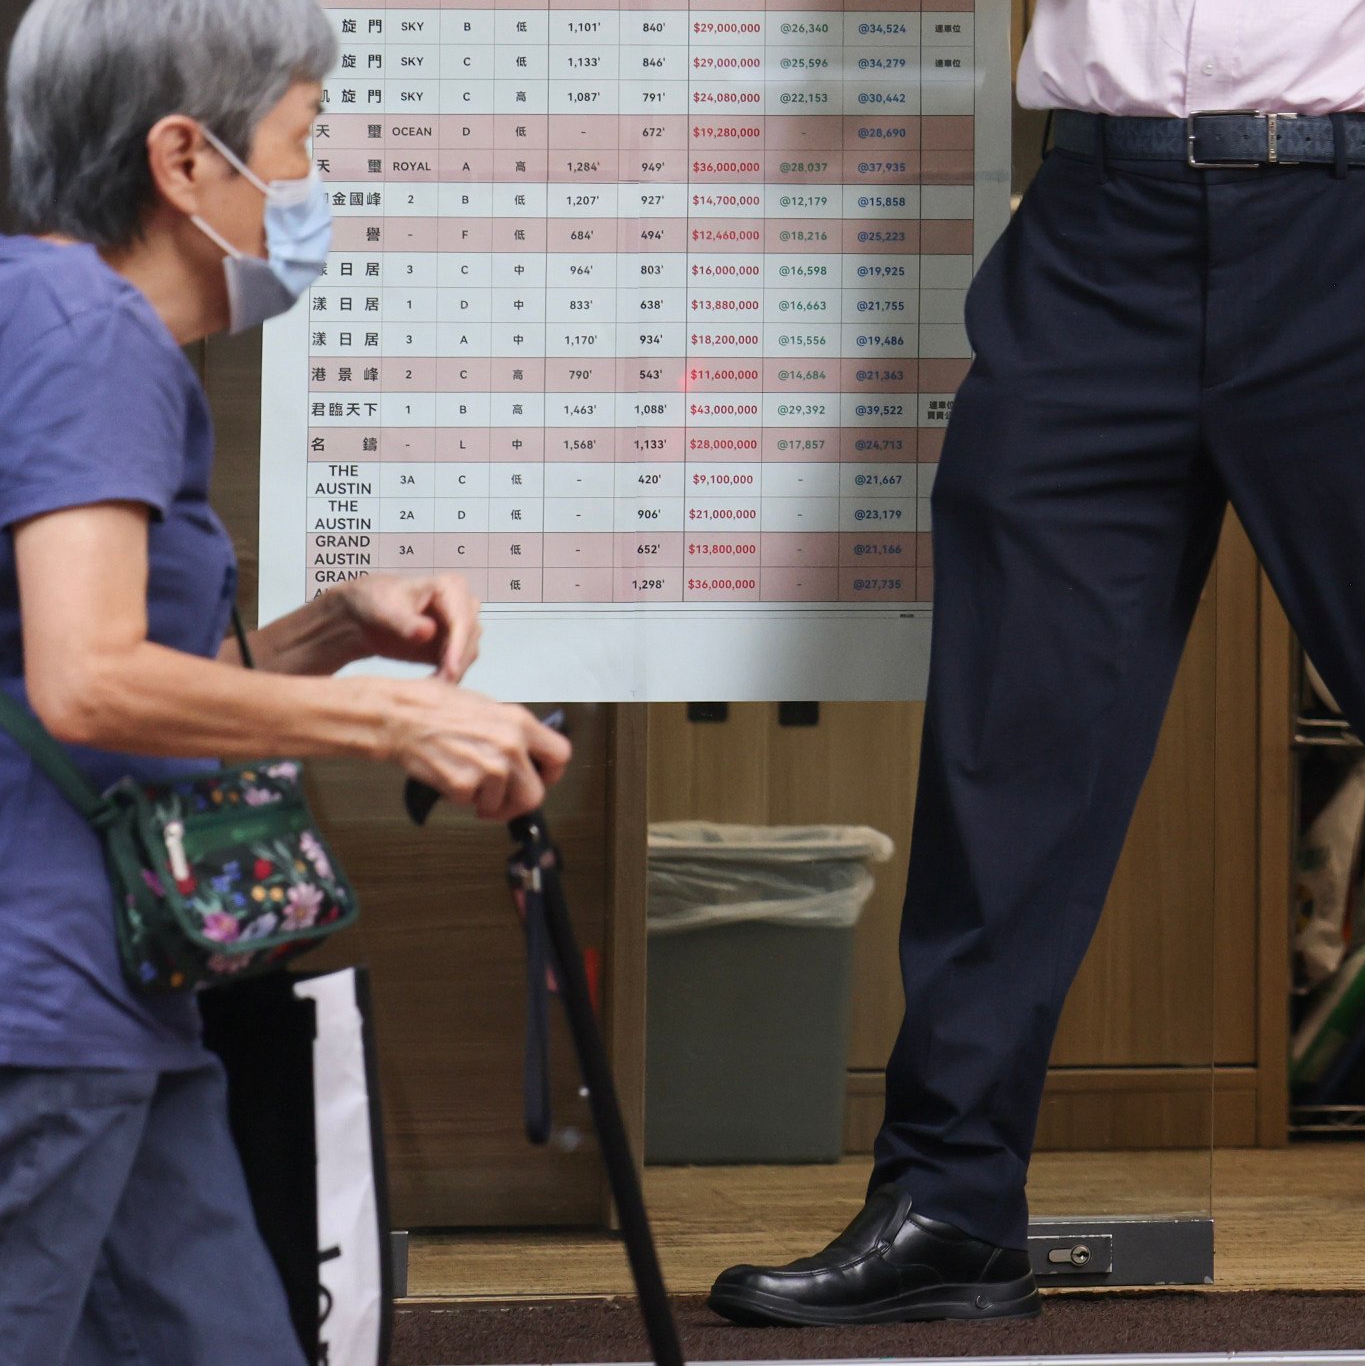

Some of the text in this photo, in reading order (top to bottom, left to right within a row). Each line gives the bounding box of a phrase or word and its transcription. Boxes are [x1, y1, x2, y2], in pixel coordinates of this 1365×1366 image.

[341, 19, 382, 34] 旋門
[401, 22, 424, 31] SKY
[464, 22, 471, 31] B
[516, 21, 527, 32] 低
[694, 22, 760, 33] $29,000,000
[311, 402, 378, 417] 君臨天下
[406, 405, 410, 414] 1
[460, 405, 467, 414] B
[513, 404, 523, 415] 高
[690, 404, 757, 415] $43,000,000
[328, 465, 359, 477] THE
[400, 475, 415, 484] 3A
[458, 475, 466, 484] C
[511, 474, 522, 485] 低
[693, 474, 753, 485] $9,100,000
[315, 482, 372, 495] AUSTIN
[315, 535, 370, 548] GRAND
[314, 553, 371, 565] AUSTIN
